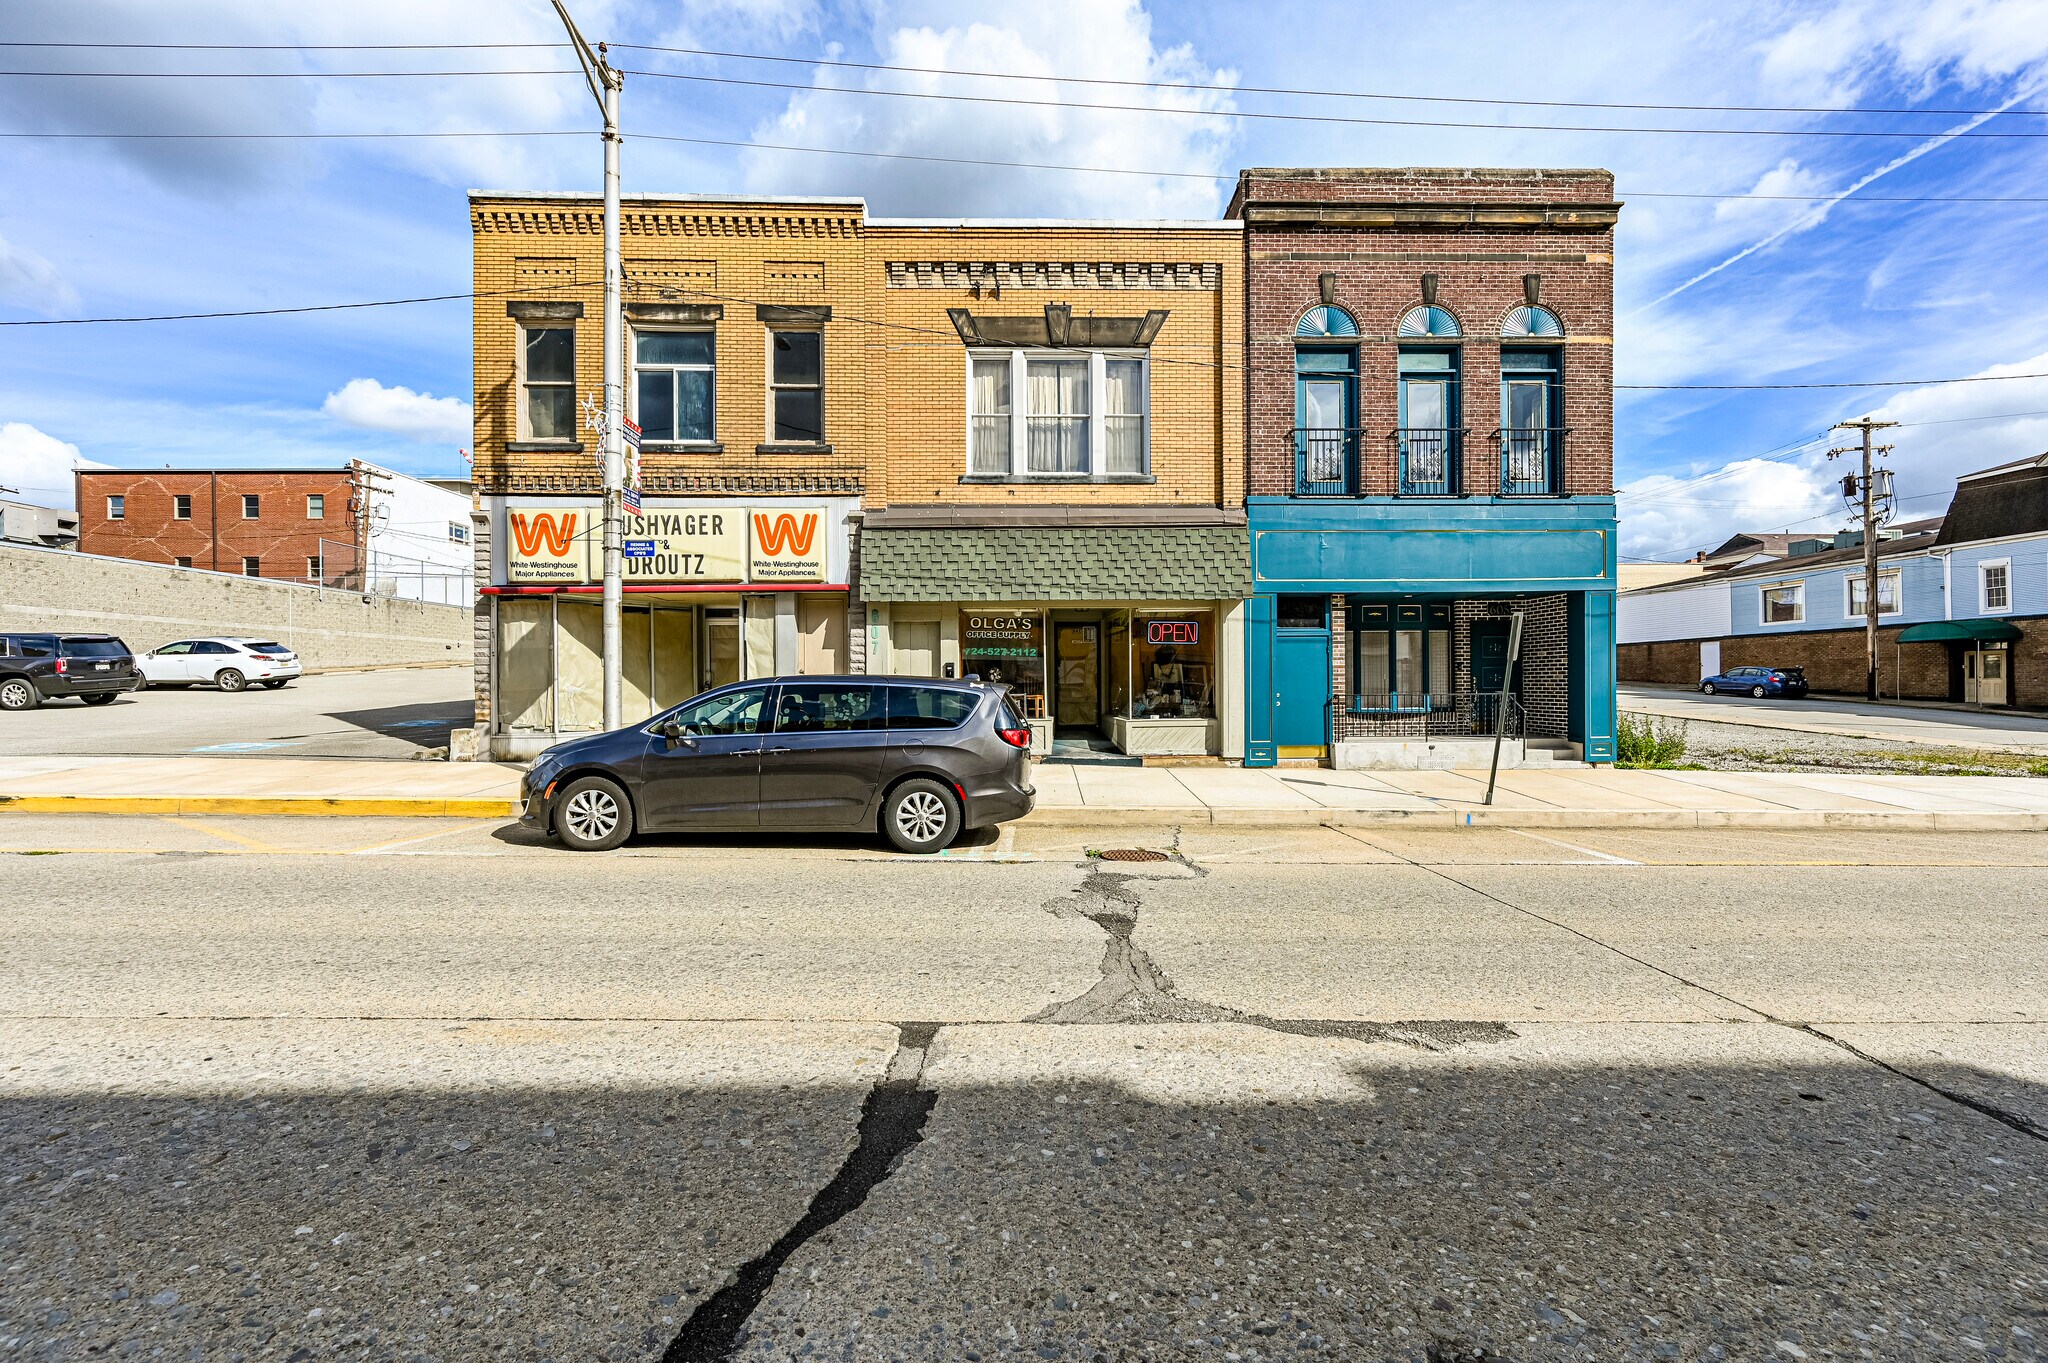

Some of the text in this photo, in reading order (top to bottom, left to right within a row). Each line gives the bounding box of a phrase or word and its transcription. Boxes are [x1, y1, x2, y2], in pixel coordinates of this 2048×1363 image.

[622, 514, 723, 536] USHYAGER
[663, 539, 670, 550] &
[509, 561, 578, 570] White-Westinghouse
[628, 553, 705, 575] DROUTZ
[752, 560, 819, 569] White-Westinghouse
[515, 570, 575, 578] Major Appliances
[758, 569, 816, 577] Major Appliances
[969, 616, 1032, 630] OLGA'S
[965, 629, 997, 639] OFFICE
[1150, 623, 1197, 642] OPEN
[964, 647, 1038, 657] 724-527-2112
